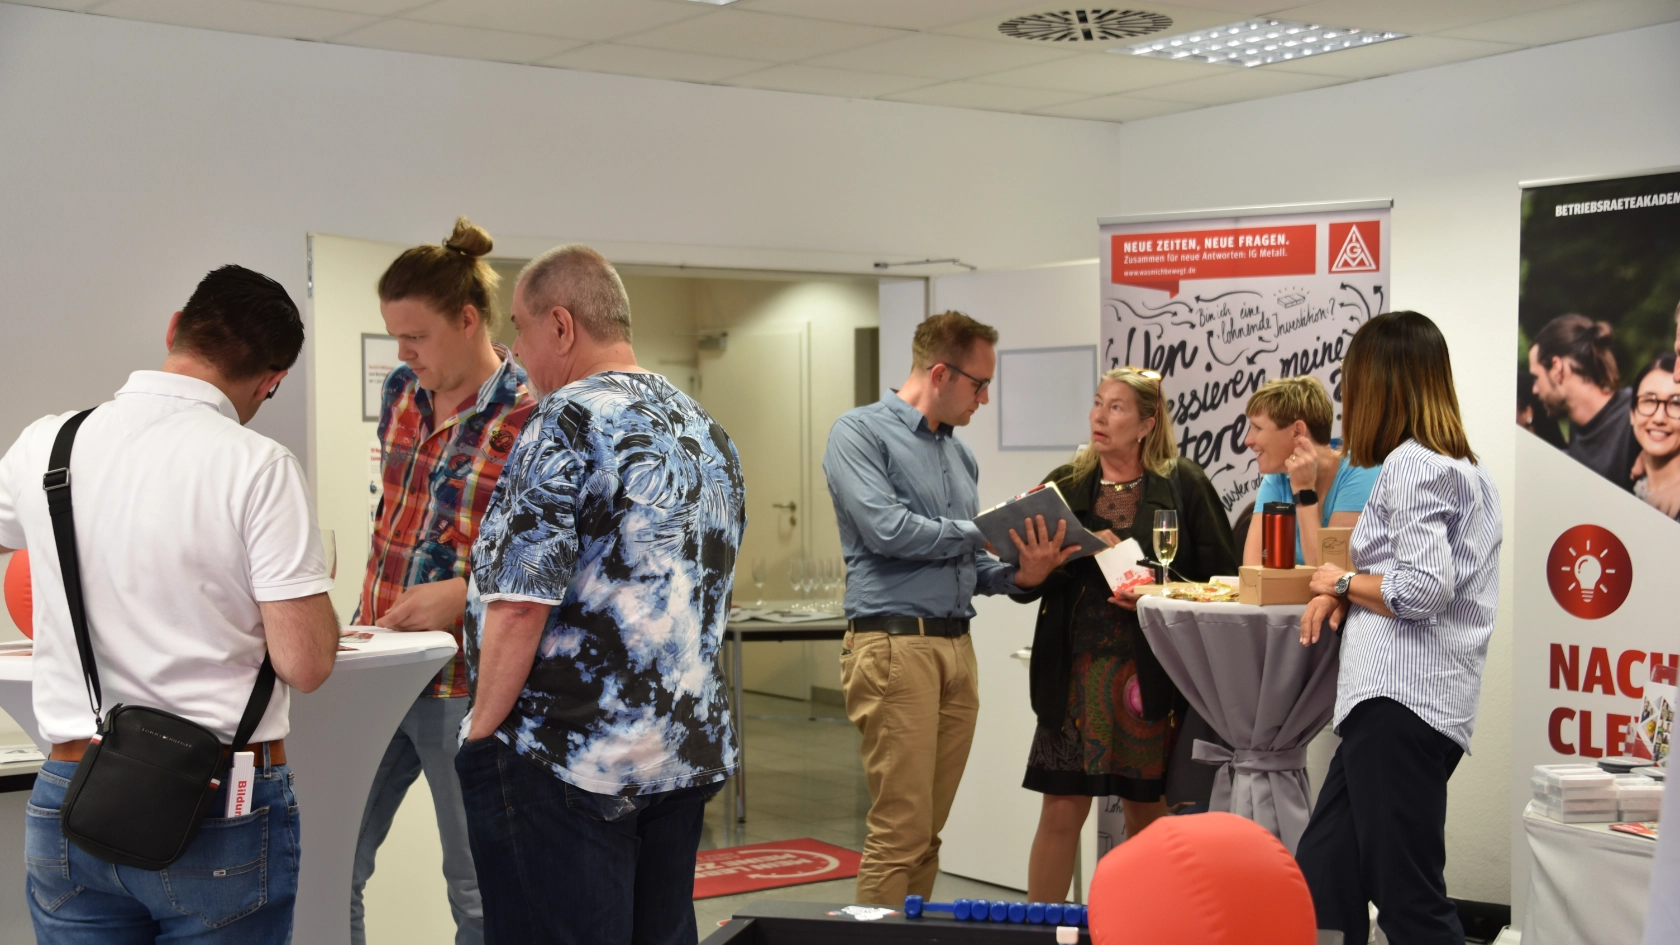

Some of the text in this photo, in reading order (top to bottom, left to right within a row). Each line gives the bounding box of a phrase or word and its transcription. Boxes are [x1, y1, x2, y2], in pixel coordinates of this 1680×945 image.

[1124, 233, 1290, 253] NEUE ZEITEN, NEUE FRAGEN.
[1123, 246, 1288, 265] Zusammen für neue Antworten: IG Metall.
[1123, 266, 1197, 277] www.wasmichbewegt.de
[1240, 302, 1260, 319] eine
